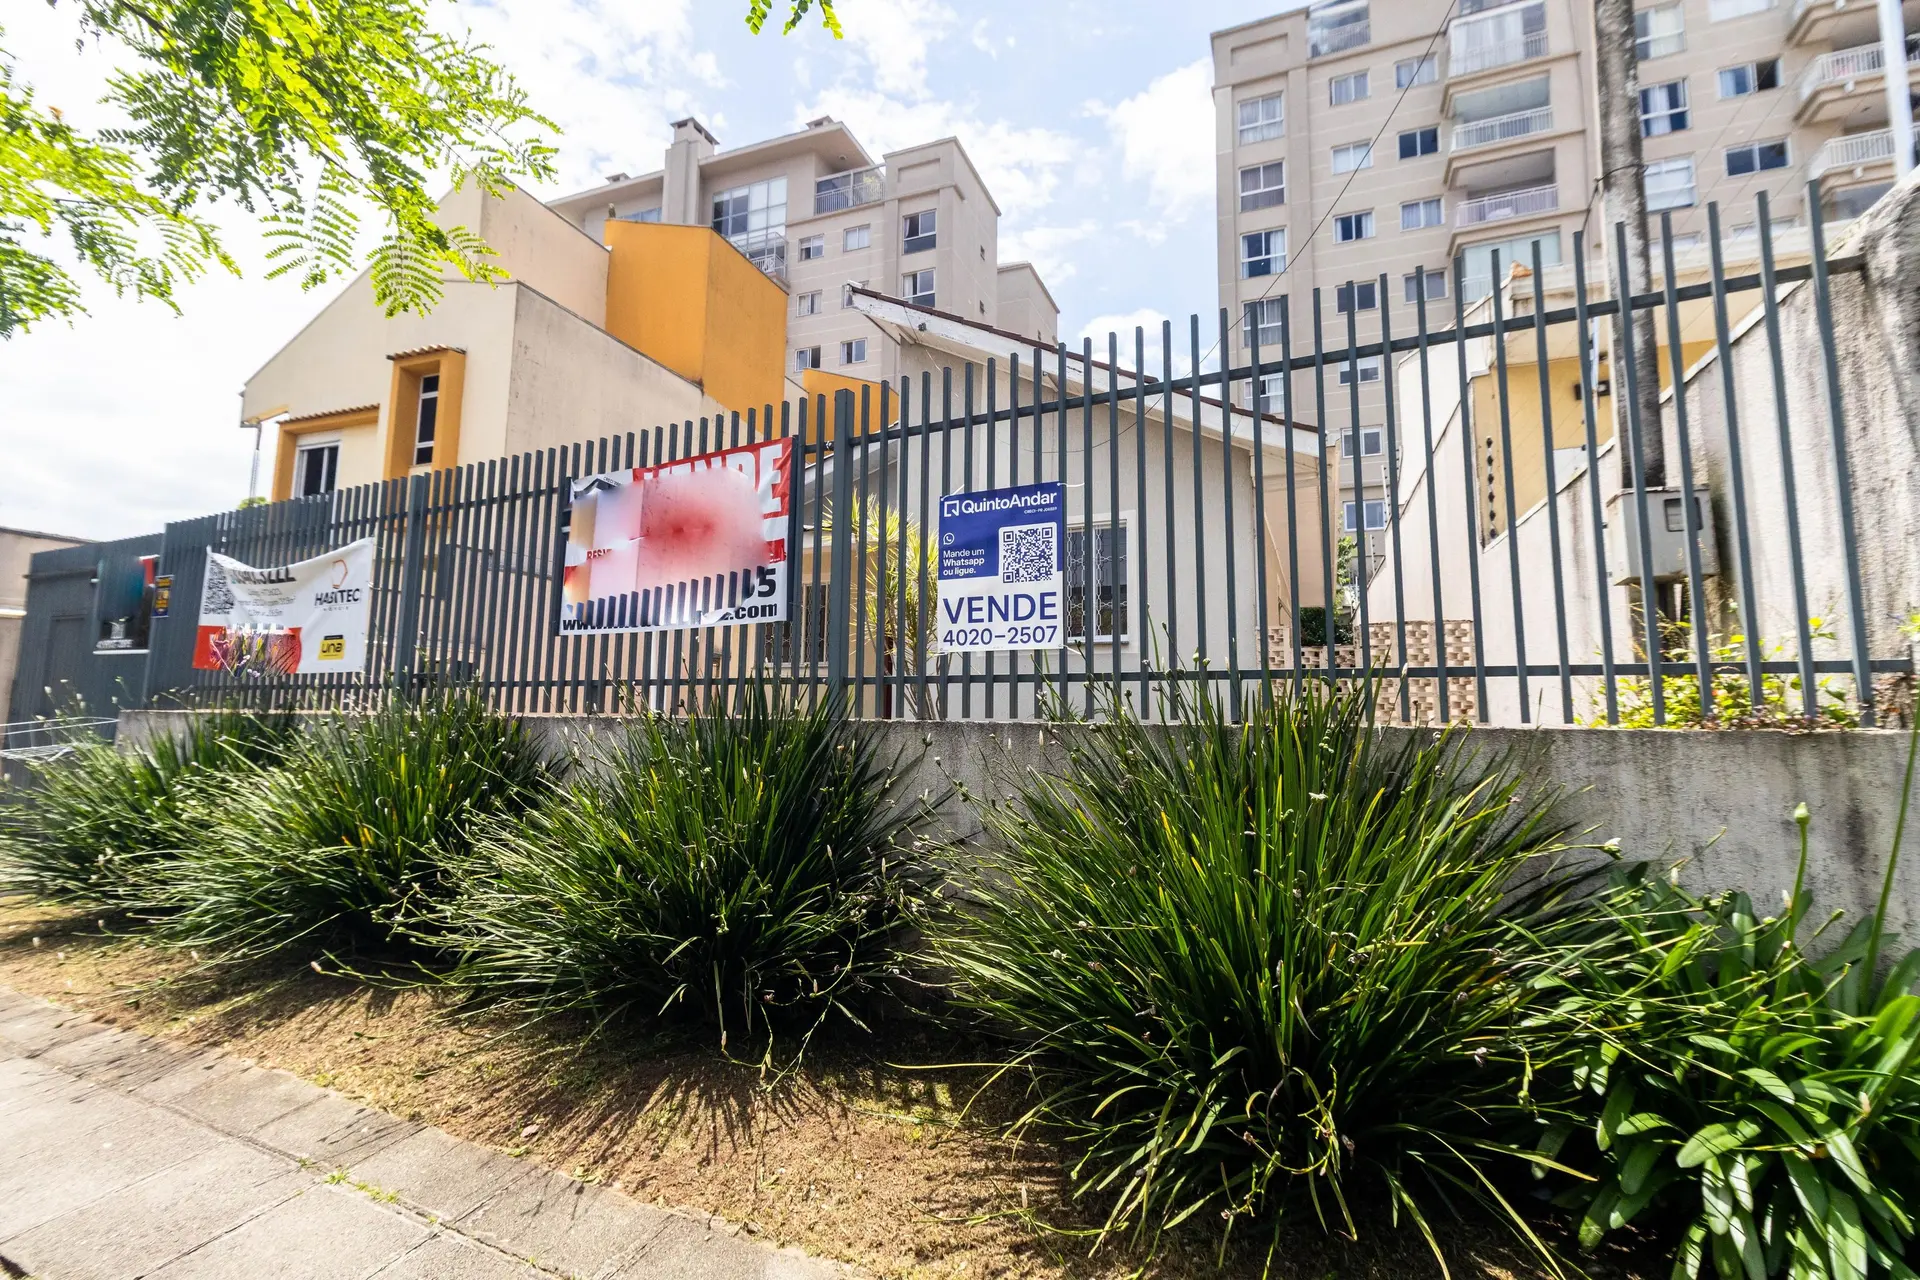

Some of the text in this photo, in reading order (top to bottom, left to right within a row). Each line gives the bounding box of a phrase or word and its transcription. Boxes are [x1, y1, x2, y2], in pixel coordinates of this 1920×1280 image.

[962, 491, 1057, 513] QuintoAndar
[943, 549, 970, 558] Mande
[943, 557, 985, 567] Whatsapp
[943, 567, 977, 576] ou ligue.
[943, 592, 1057, 624] VENDE
[943, 626, 1057, 646] 4020-2507
